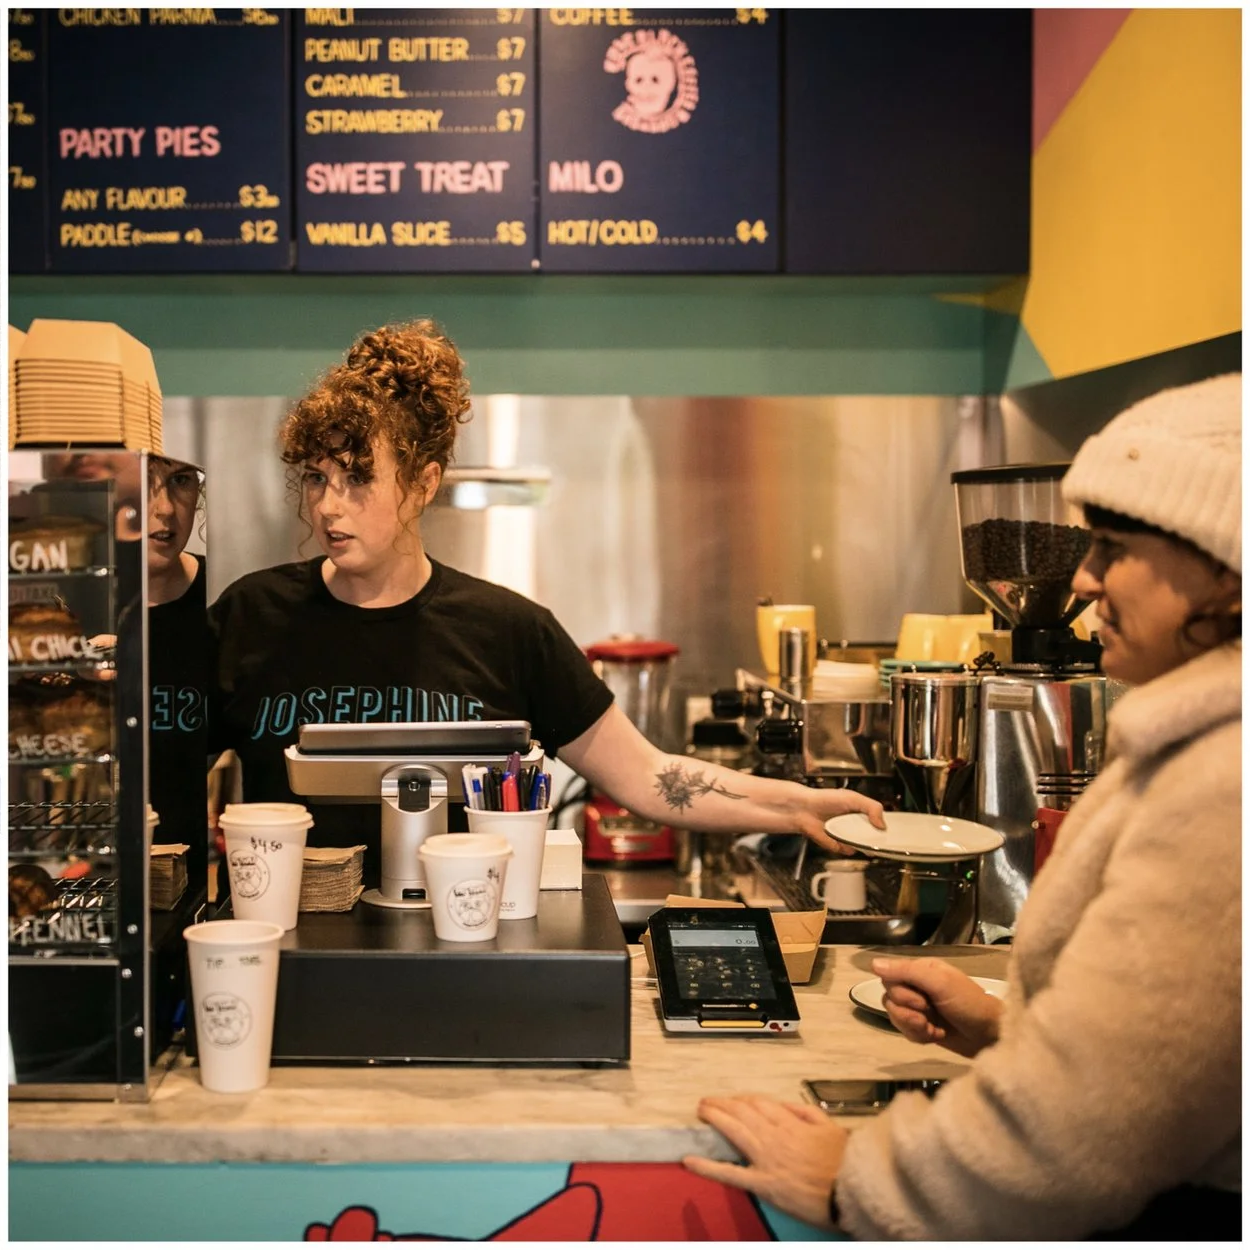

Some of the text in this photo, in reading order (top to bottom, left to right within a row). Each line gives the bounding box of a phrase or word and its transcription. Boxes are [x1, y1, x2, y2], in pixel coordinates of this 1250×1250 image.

[58, 8, 140, 27] CHICKEN
[305, 8, 354, 26] MALT
[550, 8, 768, 25] COFFEE $4
[305, 37, 526, 62] PEANUT BUTTER $7
[305, 72, 526, 98] CARAMEL $7
[305, 108, 526, 134] STRAWBERRY $7
[60, 127, 221, 158] PARTY PIES
[305, 161, 510, 194] SWEET TREAT
[549, 161, 623, 193] MILO
[61, 190, 99, 210] ANY
[105, 187, 187, 210] FLAVOUR
[60, 223, 133, 246] PADDLE
[240, 220, 278, 243] $12
[305, 221, 526, 246] VANILLA SLICE $5
[548, 220, 768, 245] HOT/COLD $4
